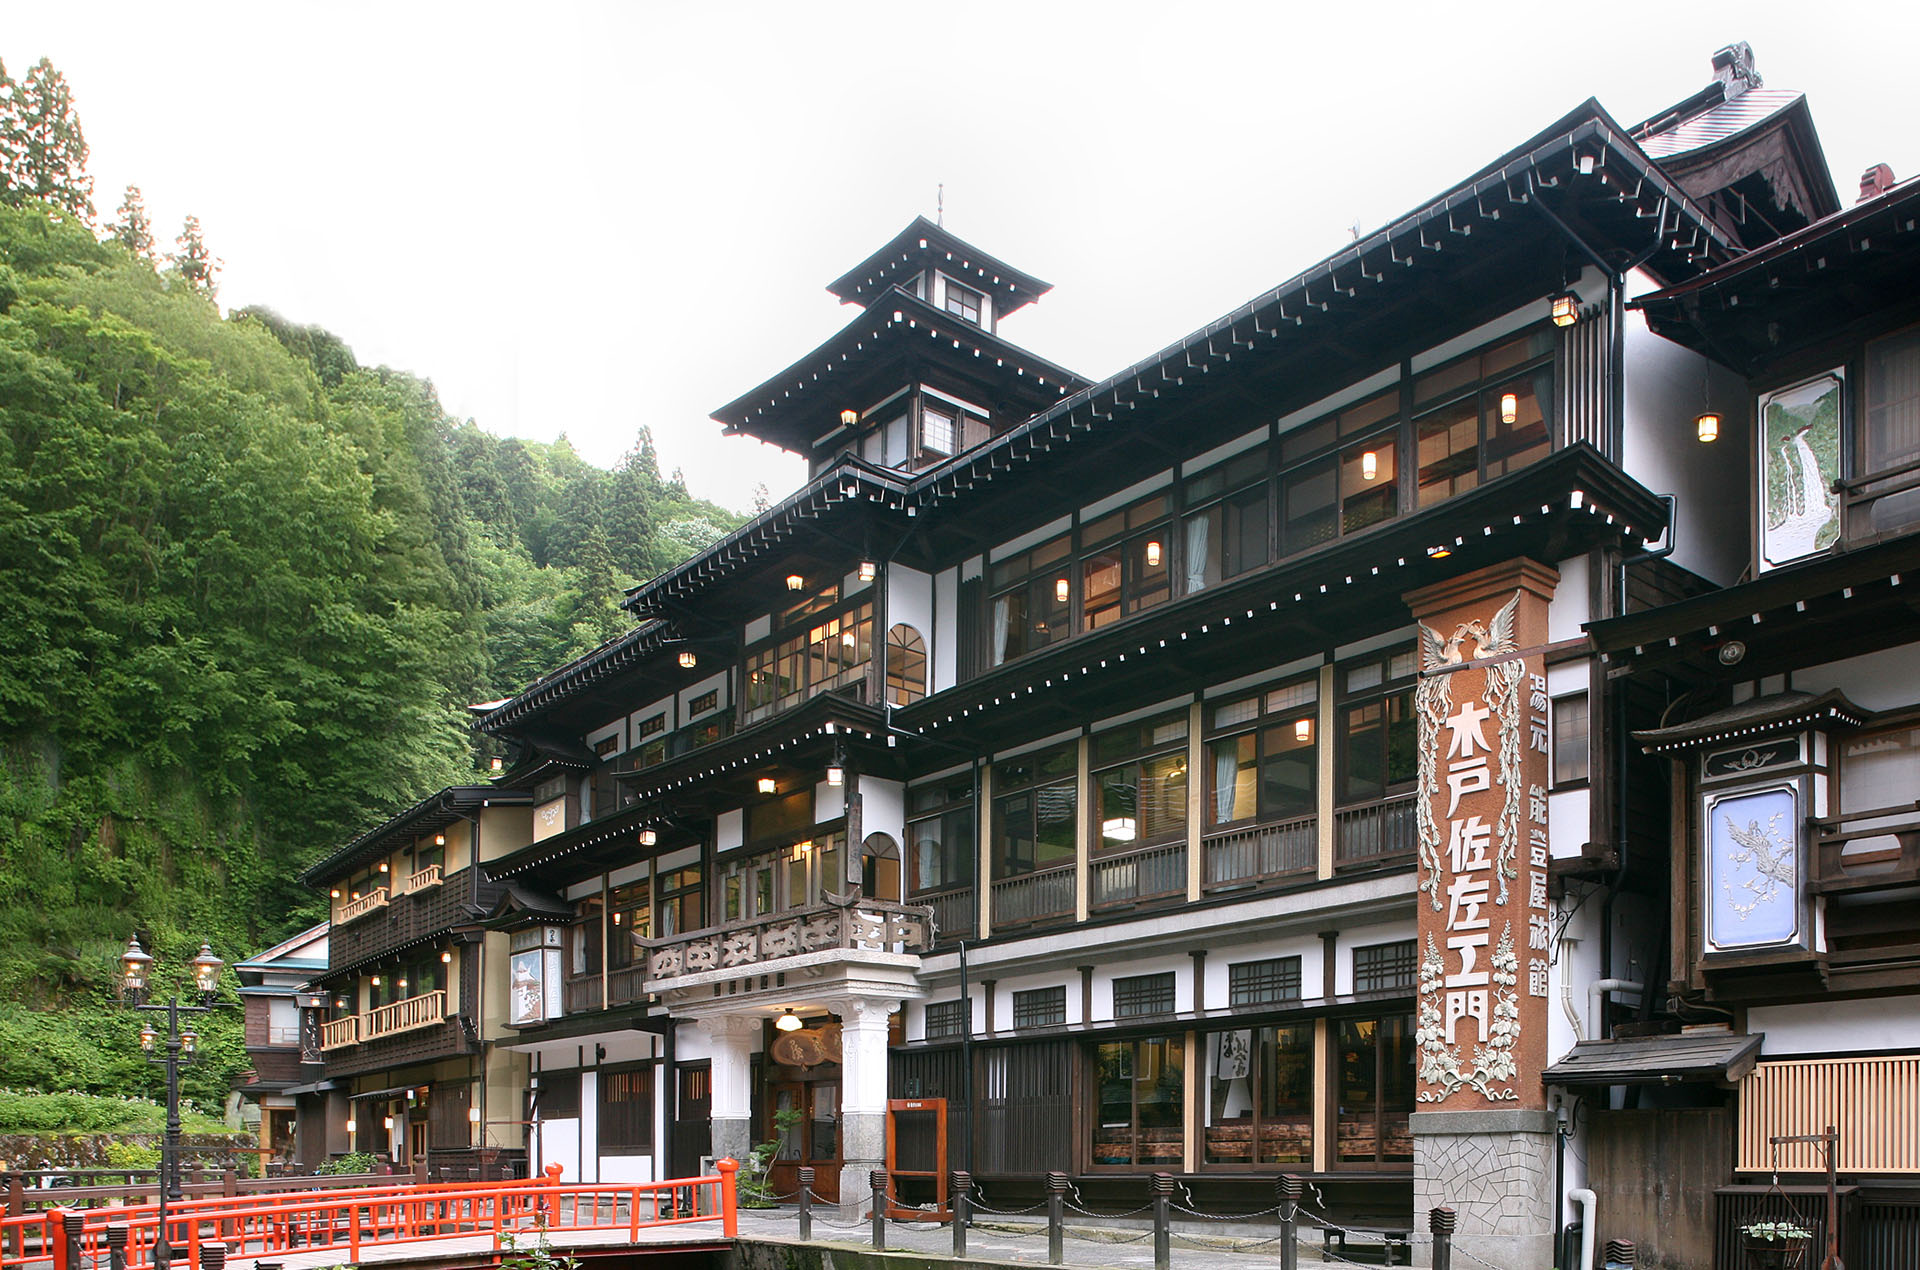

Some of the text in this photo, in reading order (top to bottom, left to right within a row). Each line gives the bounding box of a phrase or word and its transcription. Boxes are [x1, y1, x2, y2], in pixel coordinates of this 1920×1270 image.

[1529, 672, 1548, 998] 湯元 能登屋旅館
